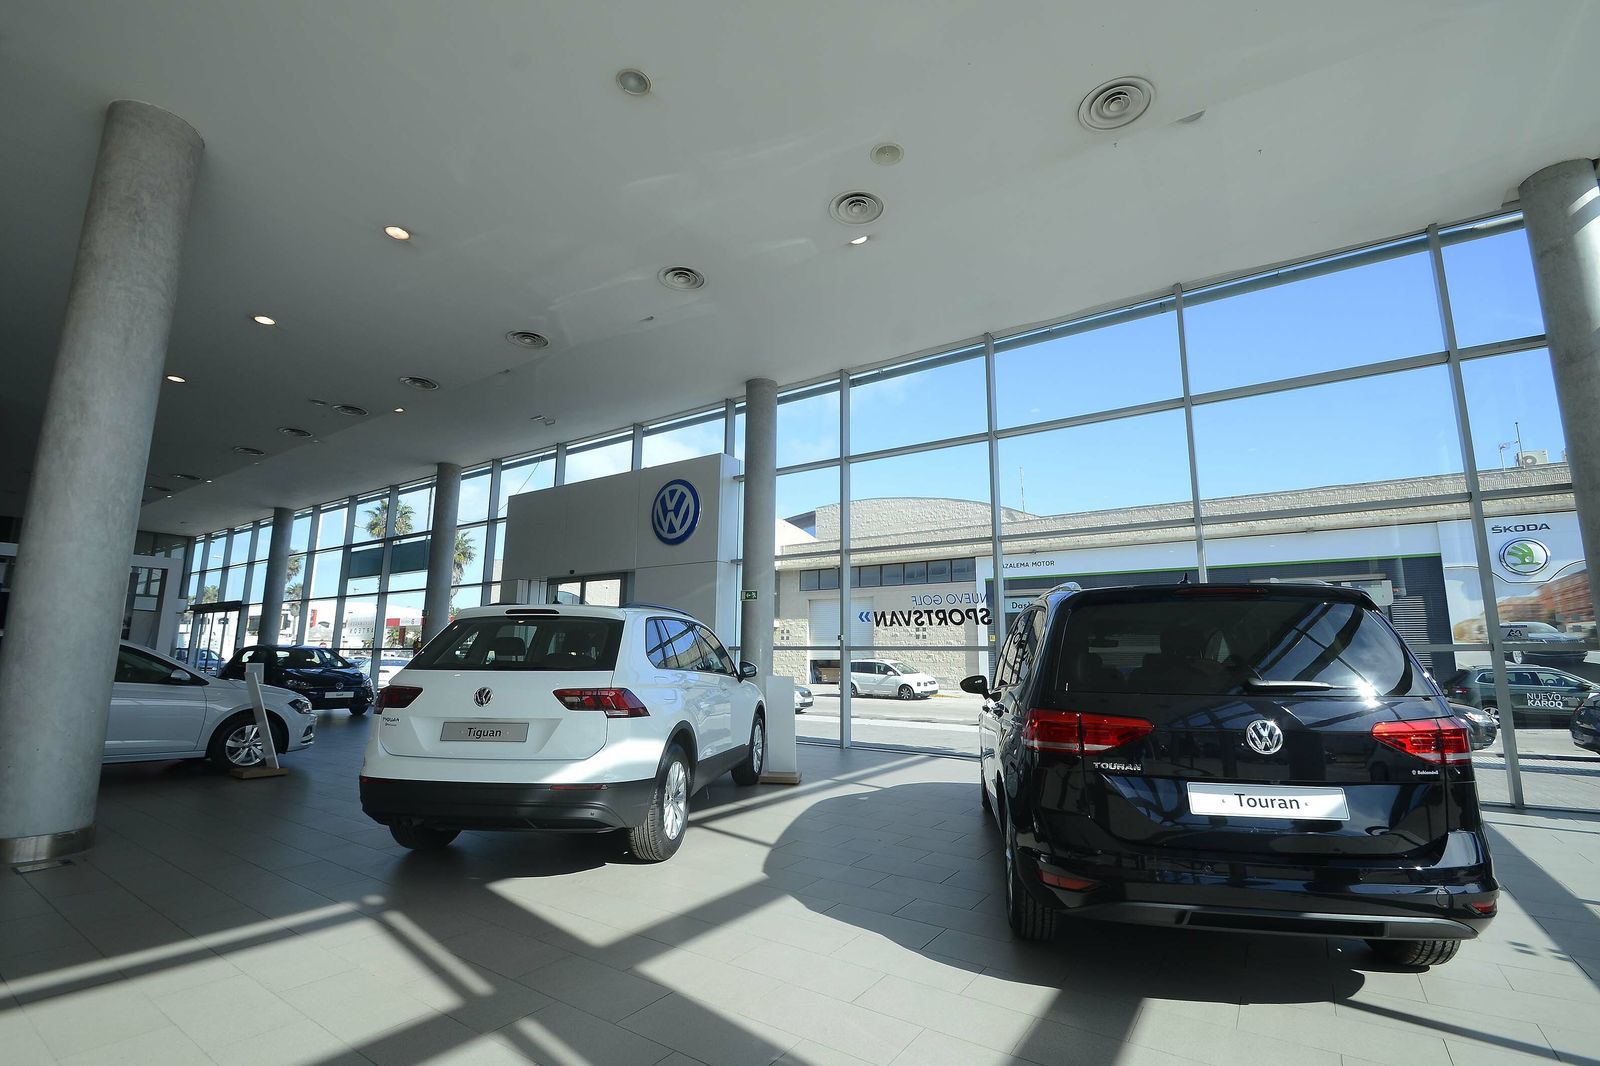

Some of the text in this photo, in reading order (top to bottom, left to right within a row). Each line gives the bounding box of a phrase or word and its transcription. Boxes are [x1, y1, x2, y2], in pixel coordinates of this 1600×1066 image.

[1491, 523, 1551, 534] ŠKODA
[1032, 560, 1055, 568] MOTOR
[1526, 692, 1561, 701] NUEVO
[1527, 699, 1563, 709] KAROQ
[467, 727, 502, 739] Tiguan
[1093, 761, 1142, 771] TOURAN
[1234, 793, 1300, 810] Touran
